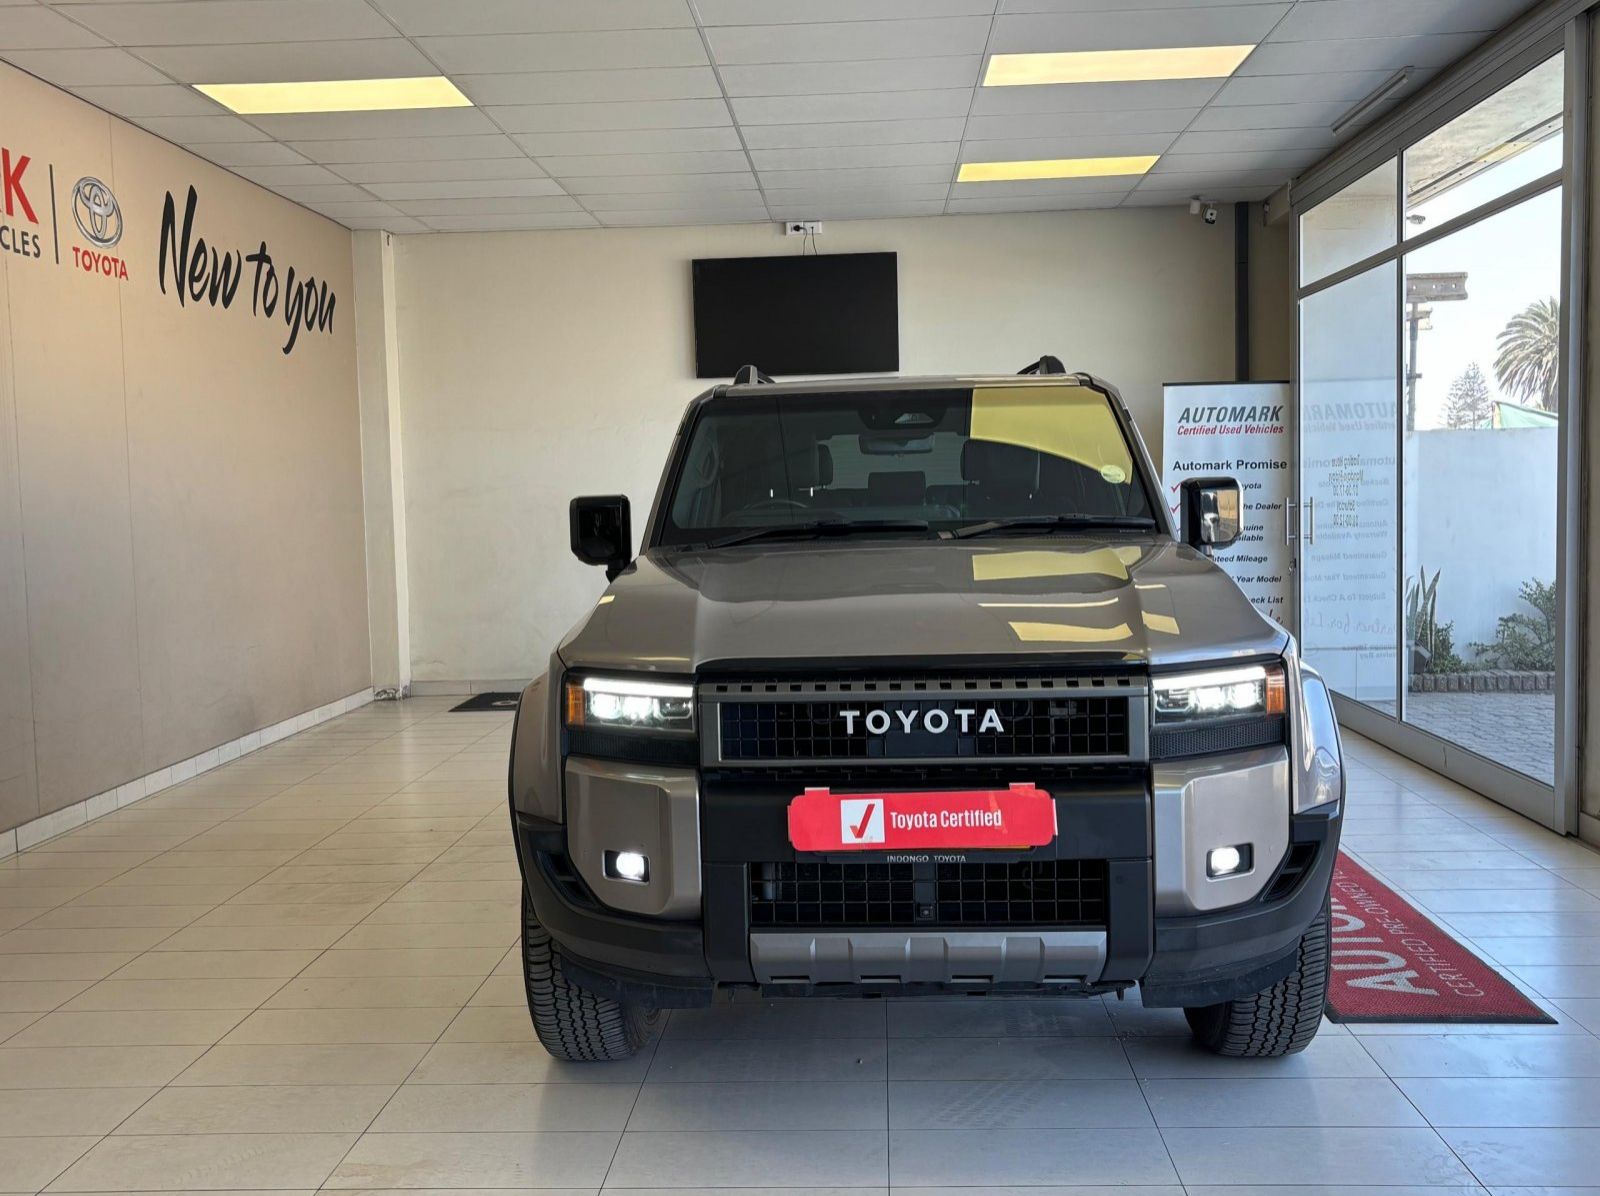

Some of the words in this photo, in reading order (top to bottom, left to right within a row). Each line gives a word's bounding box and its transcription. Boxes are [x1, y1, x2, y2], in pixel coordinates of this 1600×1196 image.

[0, 147, 39, 224] K
[0, 225, 41, 259] CLES
[72, 246, 129, 281] TOYOTA
[158, 184, 242, 309] New
[246, 240, 279, 318] to
[282, 265, 337, 355] you
[1178, 405, 1284, 423] AUTOMARK
[1177, 425, 1218, 436] Certified
[1219, 424, 1242, 435] Used
[1244, 423, 1285, 435] Vehicles
[1173, 460, 1233, 471] Automark
[1236, 459, 1288, 470] Promise
[1242, 482, 1262, 490] yota
[1243, 502, 1254, 510] he
[1255, 502, 1282, 510] Dealer
[1236, 554, 1268, 564] Mileage
[1236, 575, 1255, 583] Year
[1256, 575, 1282, 583] Model
[1249, 596, 1266, 604] eck
[1267, 596, 1284, 604] List
[839, 708, 1005, 736] TOYOTA
[890, 810, 938, 829] Toyota
[940, 808, 1002, 828] Certified
[886, 855, 929, 863] INDONGO
[934, 855, 967, 863] TOYOTA
[1330, 897, 1440, 997] AUTO
[1400, 937, 1485, 998] CERTIFIED
